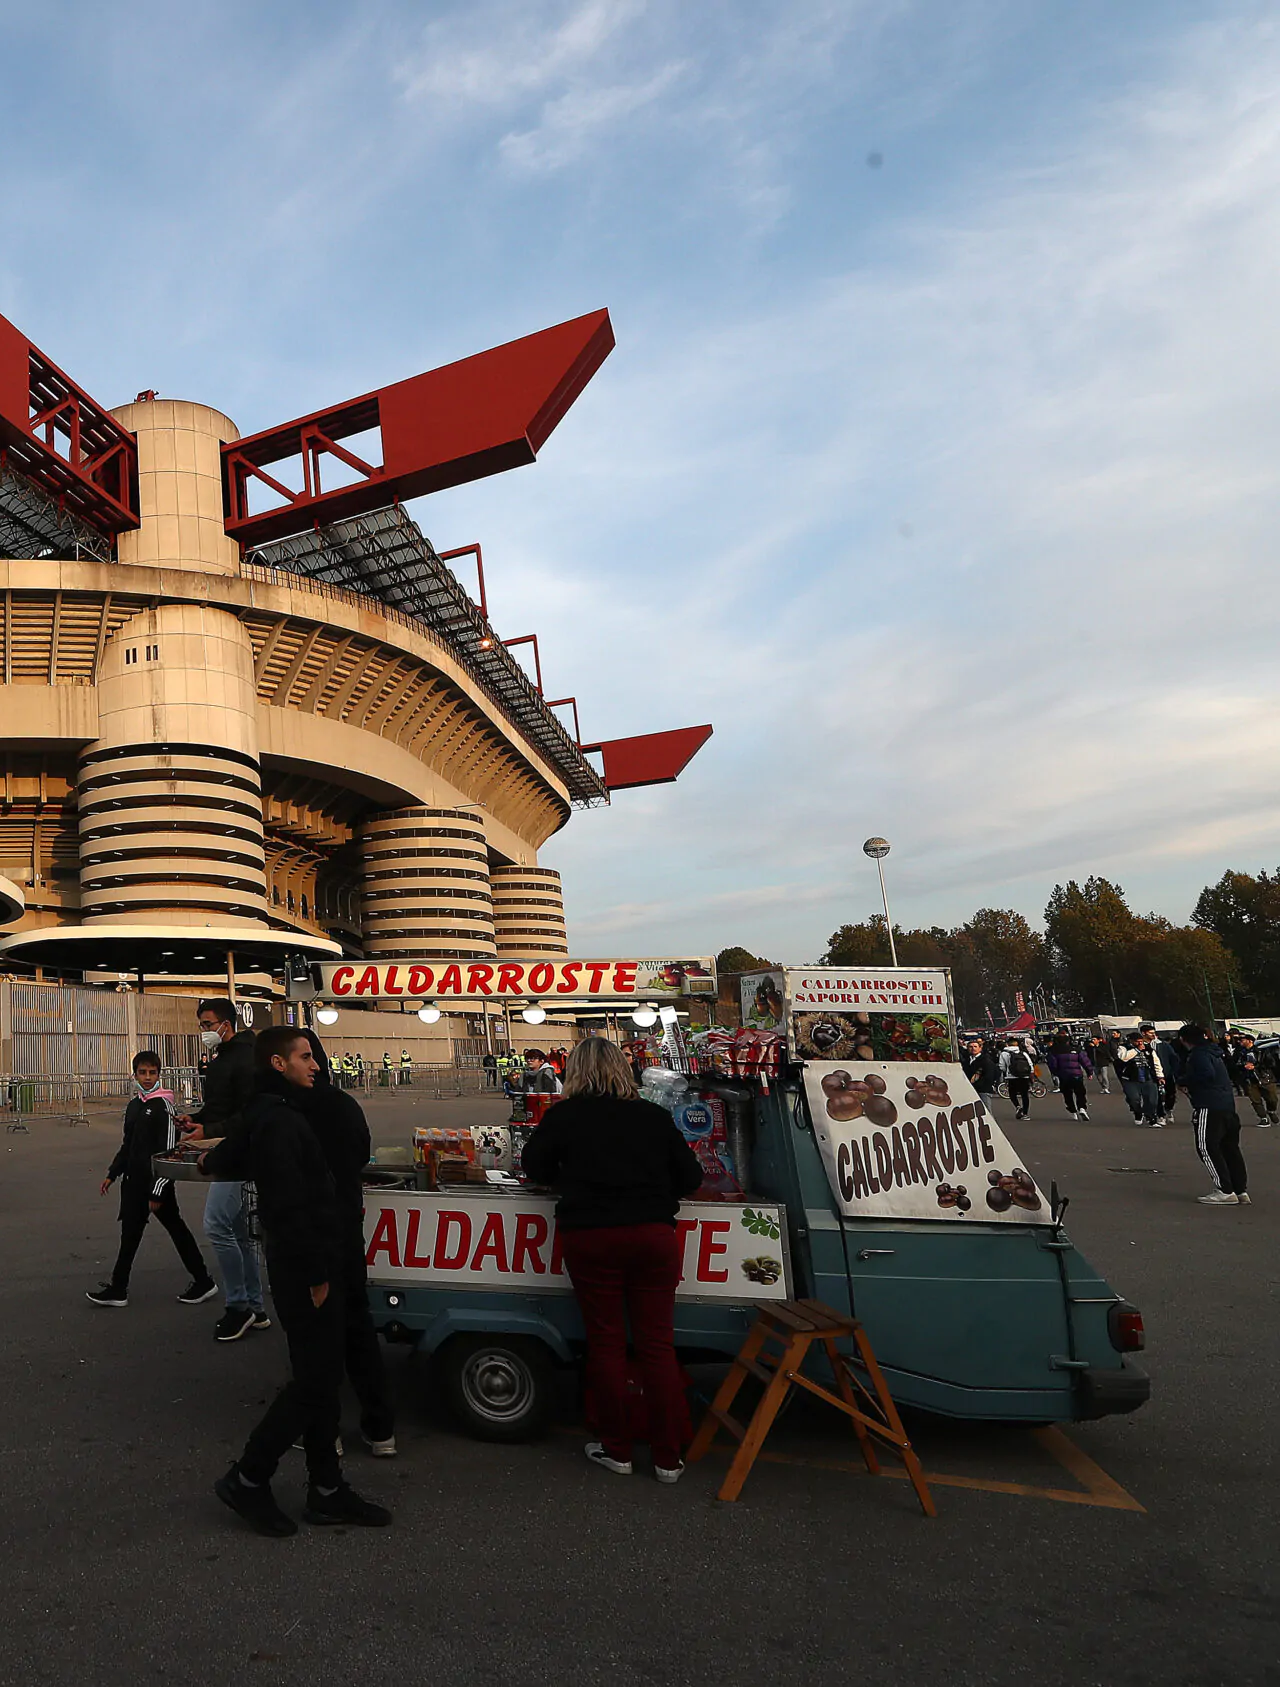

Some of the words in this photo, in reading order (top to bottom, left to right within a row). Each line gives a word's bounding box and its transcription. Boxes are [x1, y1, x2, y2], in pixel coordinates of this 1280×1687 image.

[331, 962, 638, 996] CALDARROSTE
[802, 978, 934, 992] CALDARROSTE
[795, 992, 861, 1005] SAPORI
[867, 993, 943, 1006] ANTICHI
[244, 1003, 252, 1025] 12
[687, 1115, 707, 1123] Vera
[837, 1100, 995, 1203] CALDARROSTE
